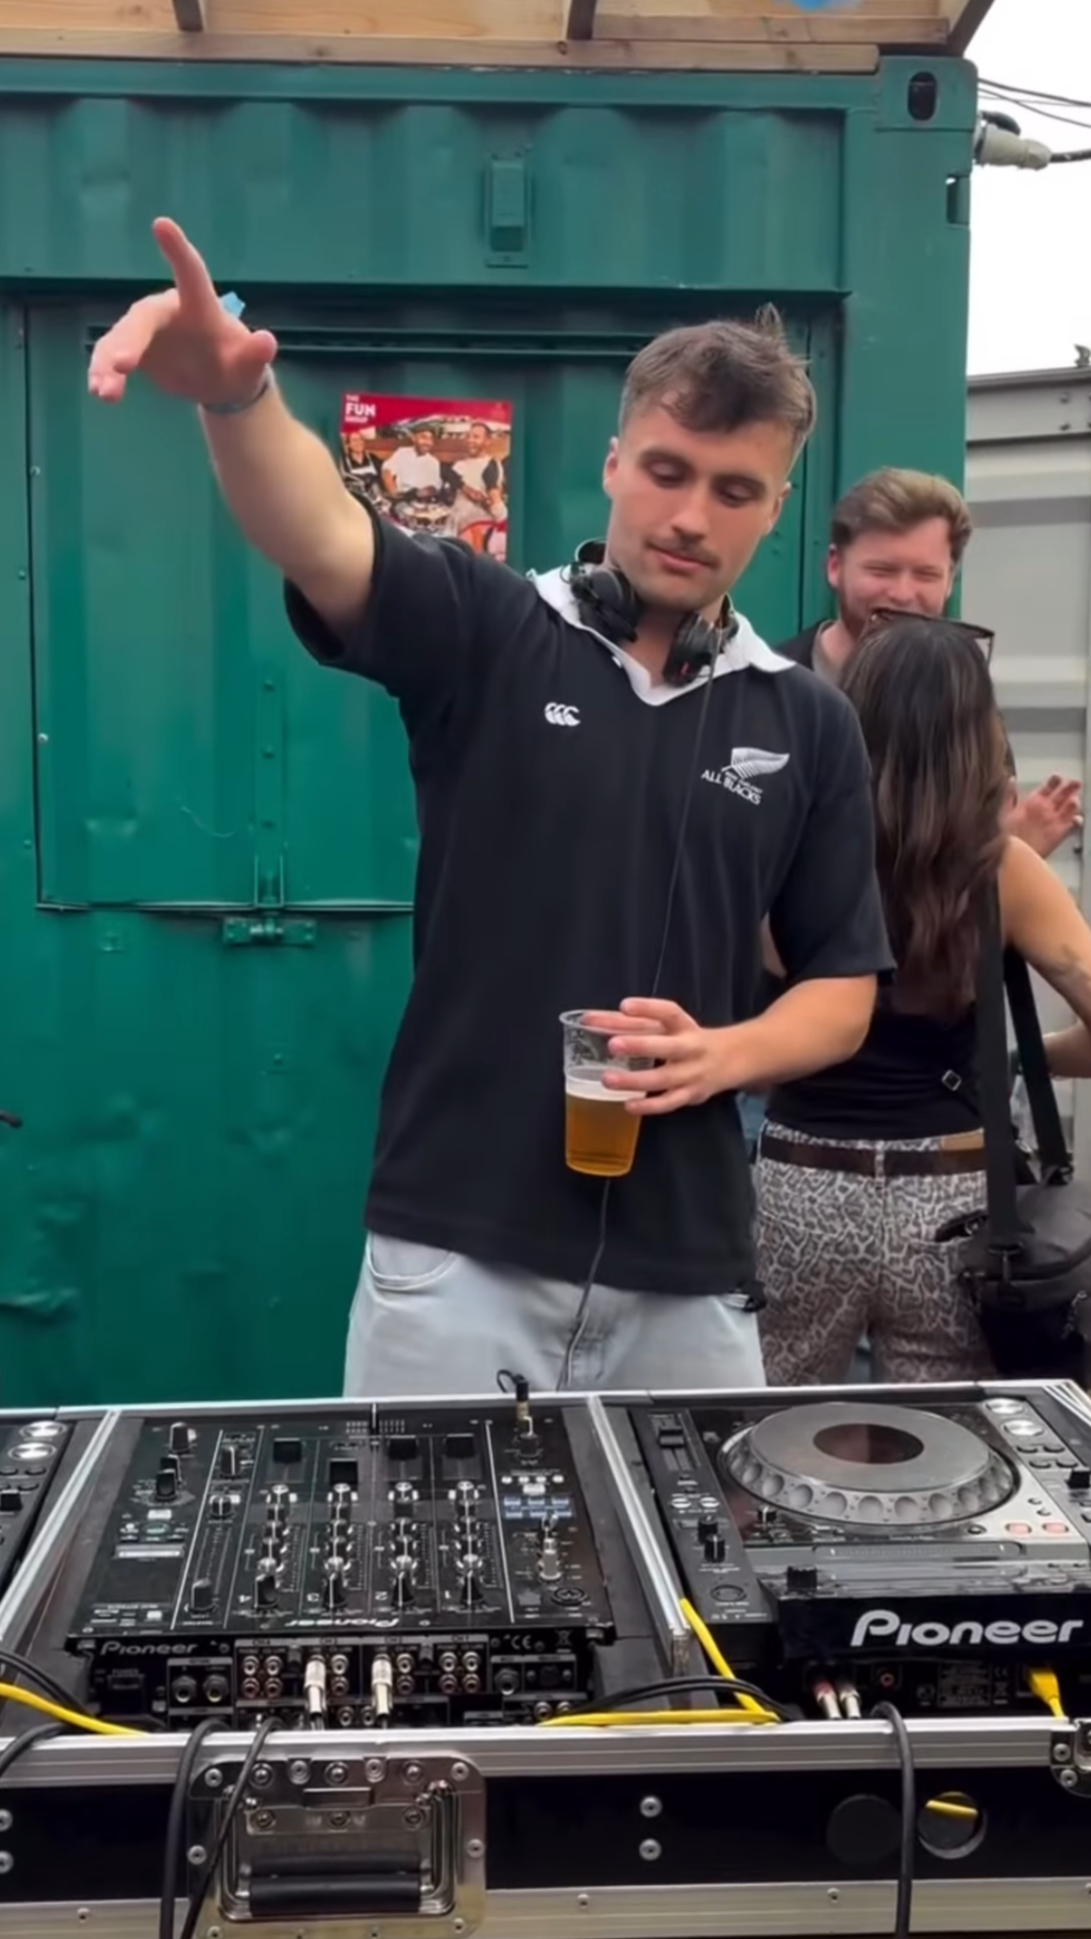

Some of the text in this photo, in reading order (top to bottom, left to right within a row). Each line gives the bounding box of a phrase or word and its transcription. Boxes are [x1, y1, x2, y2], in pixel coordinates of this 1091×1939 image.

[345, 402, 376, 418] FUN
[701, 769, 722, 785] ALL
[284, 1618, 400, 1628] Pioneer
[850, 1609, 1084, 1647] Pioneer
[101, 1641, 198, 1656] Pioneer
